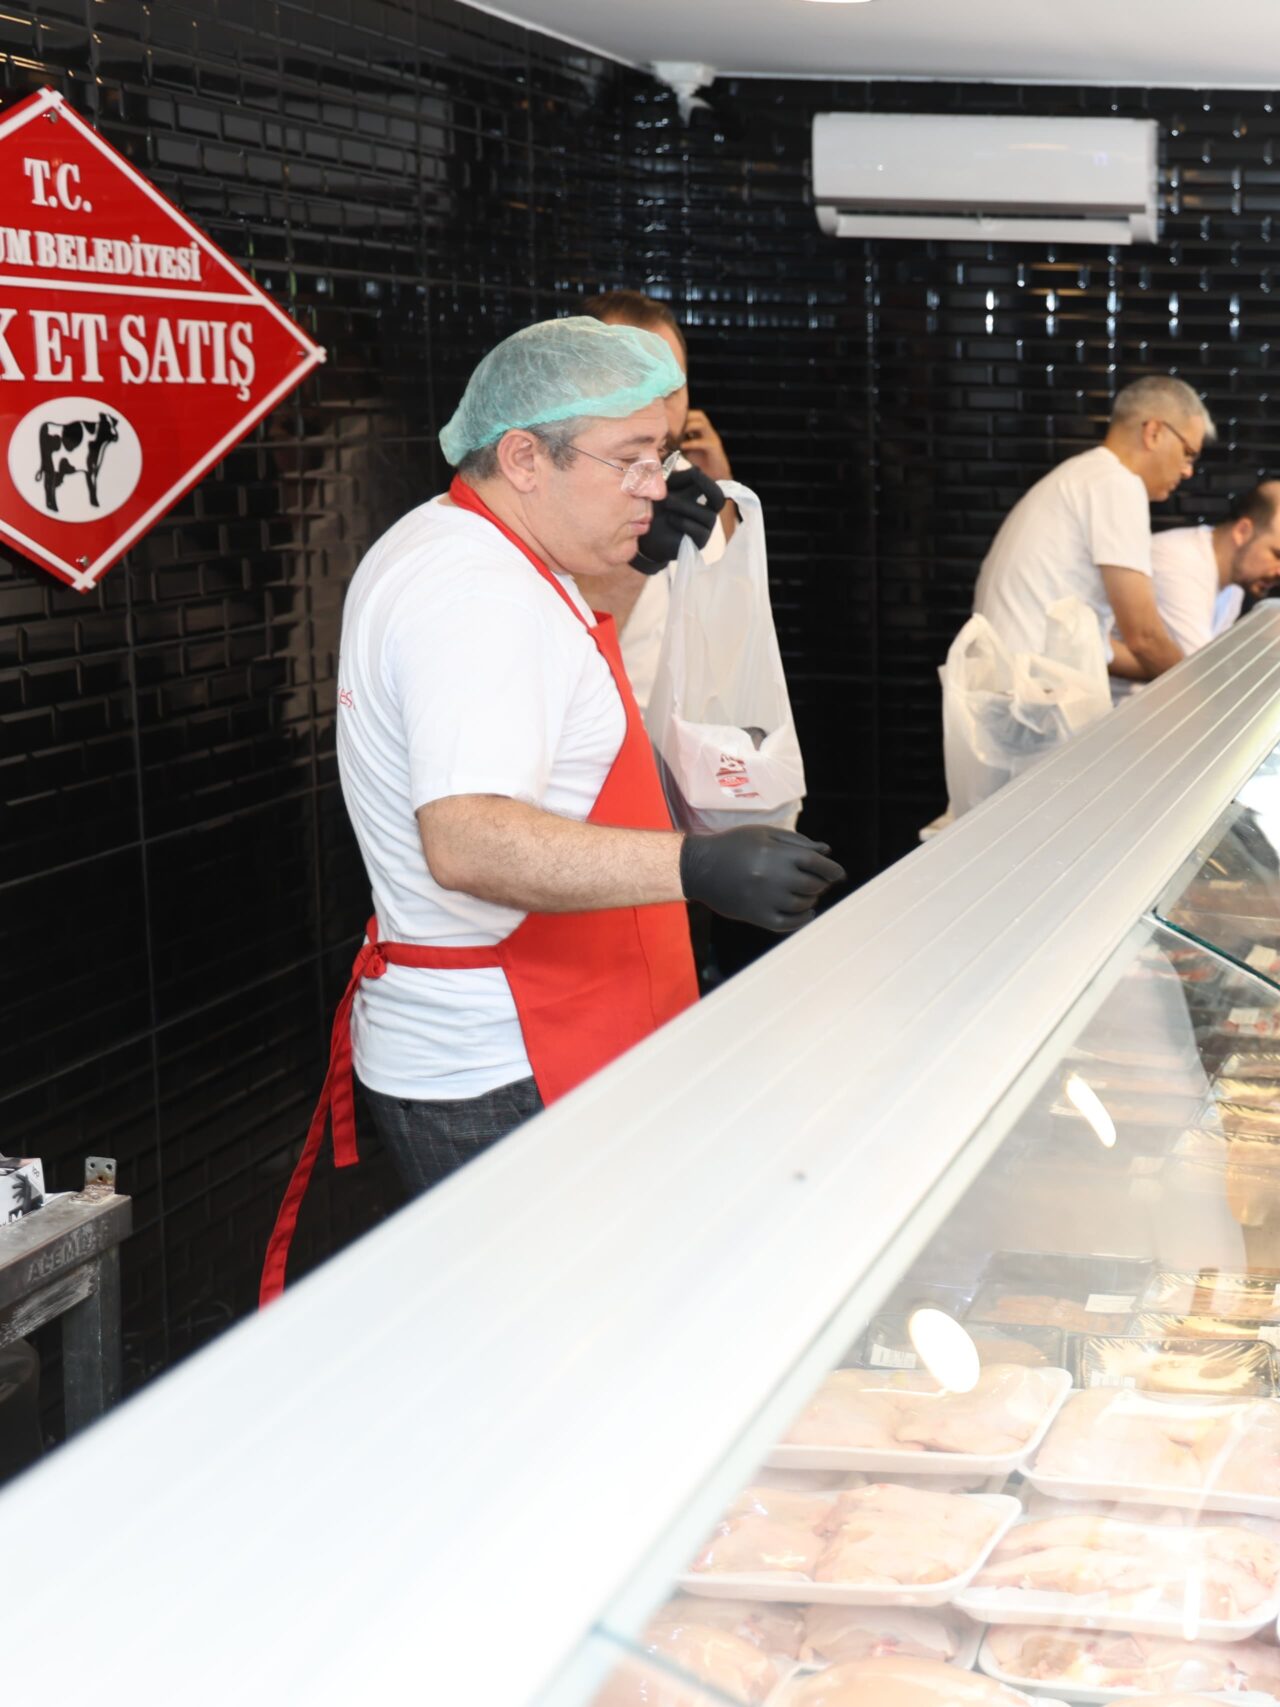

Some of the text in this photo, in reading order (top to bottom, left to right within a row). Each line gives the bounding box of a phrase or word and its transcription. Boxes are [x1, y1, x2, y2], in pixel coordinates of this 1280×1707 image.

[24, 157, 93, 213] T.C.
[34, 231, 202, 282] BELEDİYESİ
[119, 314, 256, 402] SATIŞ
